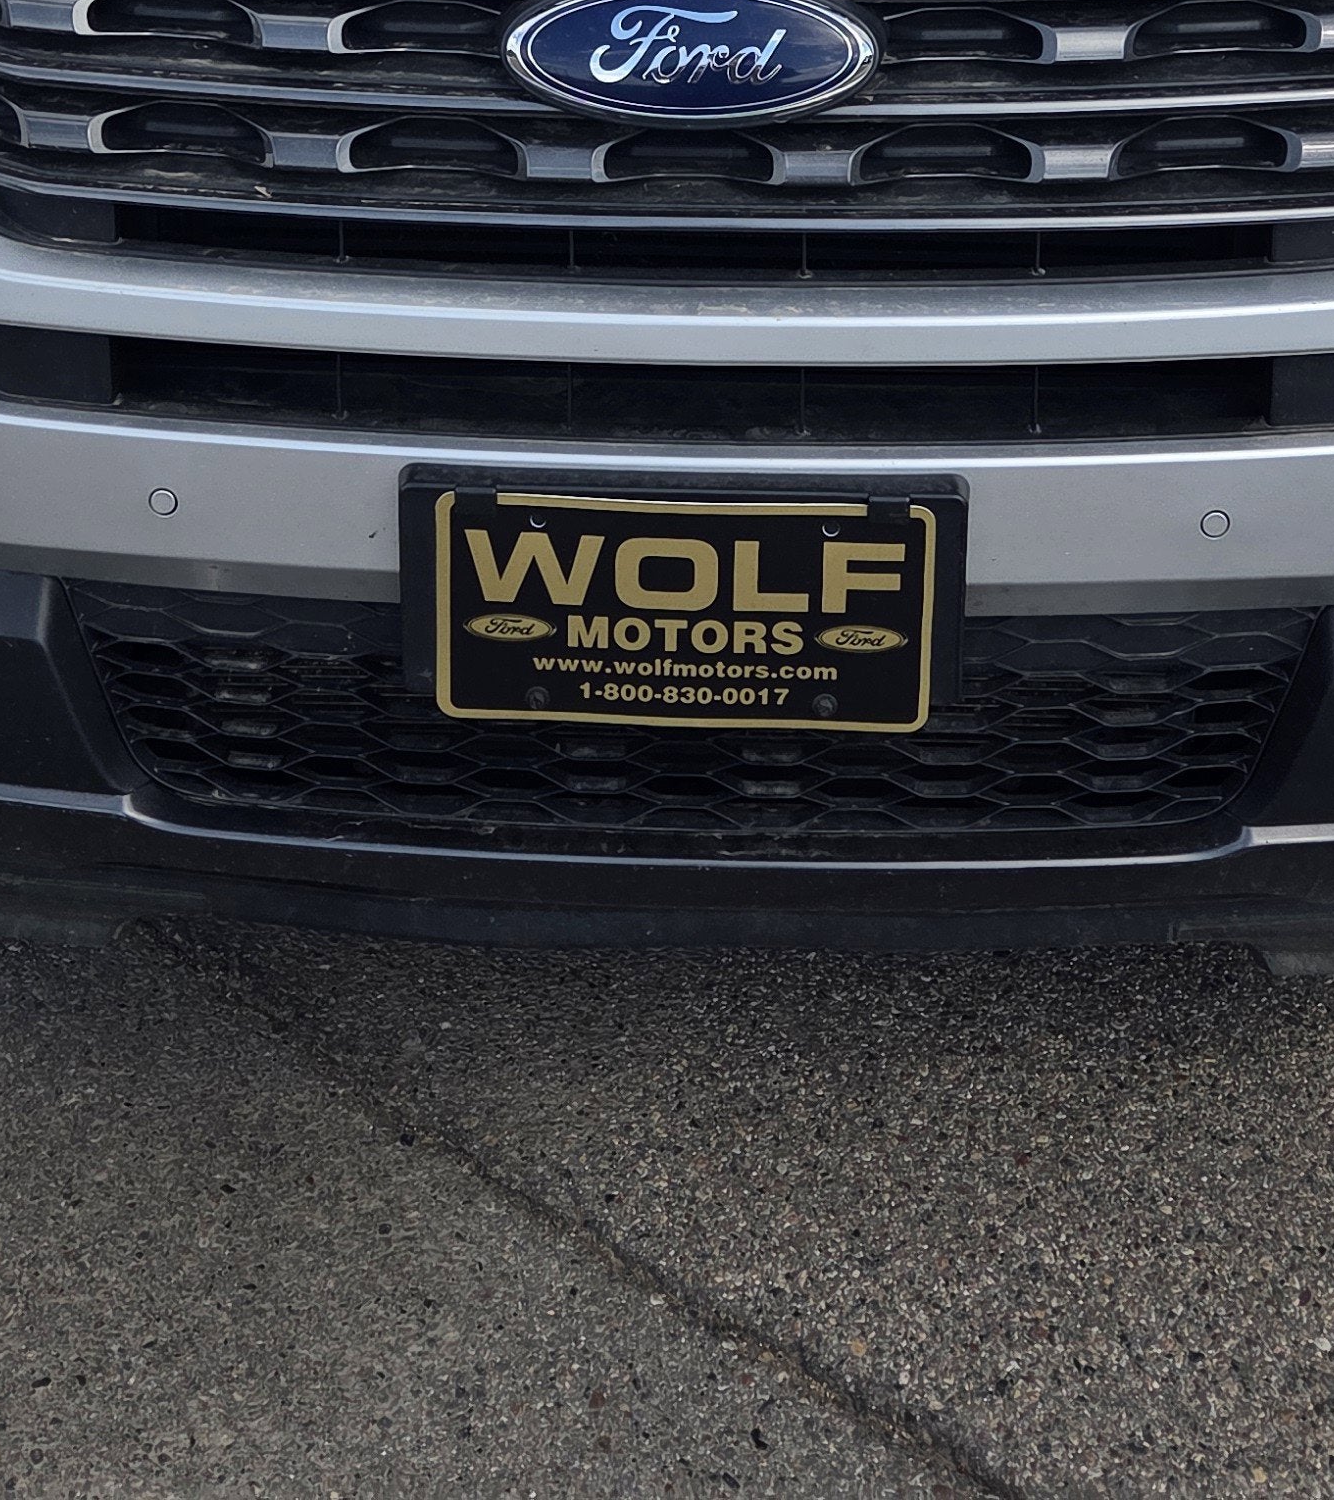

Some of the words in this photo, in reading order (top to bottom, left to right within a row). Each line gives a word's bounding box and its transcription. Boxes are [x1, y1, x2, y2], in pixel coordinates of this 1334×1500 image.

[589, 4, 788, 85] Ford
[463, 528, 906, 614] WOLF
[484, 617, 536, 636] Ford
[567, 614, 805, 655] MOTORS
[835, 629, 887, 647] Ford
[532, 657, 839, 681] www.wolfmotors.com
[579, 681, 791, 706] 1-800-830-0017
